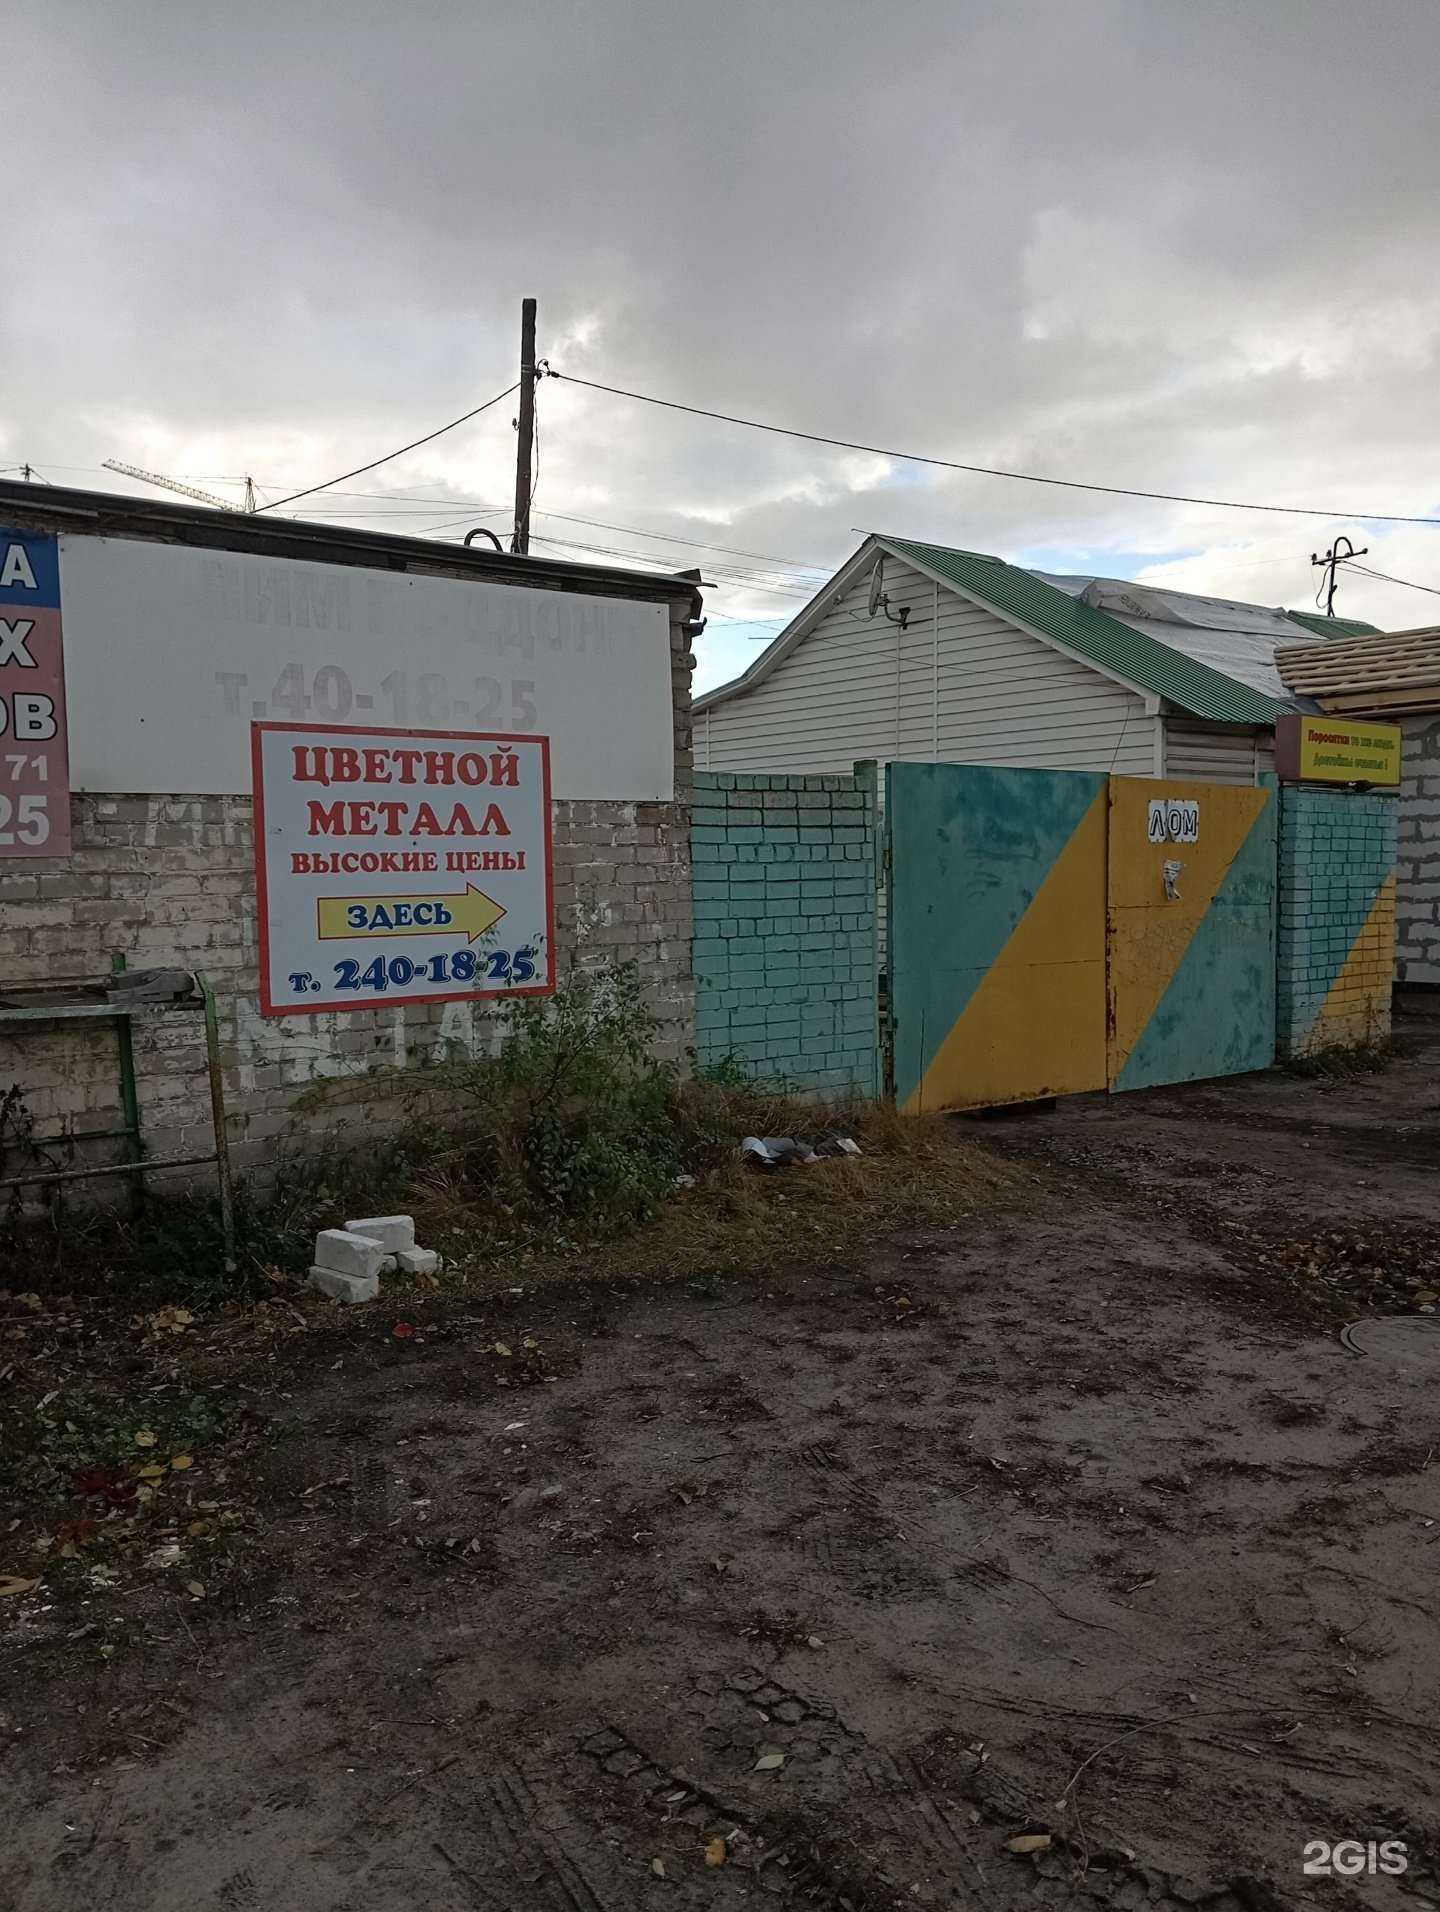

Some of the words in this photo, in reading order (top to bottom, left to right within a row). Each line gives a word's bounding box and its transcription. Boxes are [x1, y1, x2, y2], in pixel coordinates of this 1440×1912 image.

[292, 745, 520, 787] ЦВЕТНОЙ
[307, 801, 511, 836] МЕТАЛЛ
[1149, 809, 1197, 836] ЛОМ
[291, 852, 438, 873] ВЫСОКИЕ
[446, 851, 526, 873] ЦЕНЫ
[348, 902, 452, 930] ЗДЕСЬ
[333, 949, 536, 992] 240-18-25
